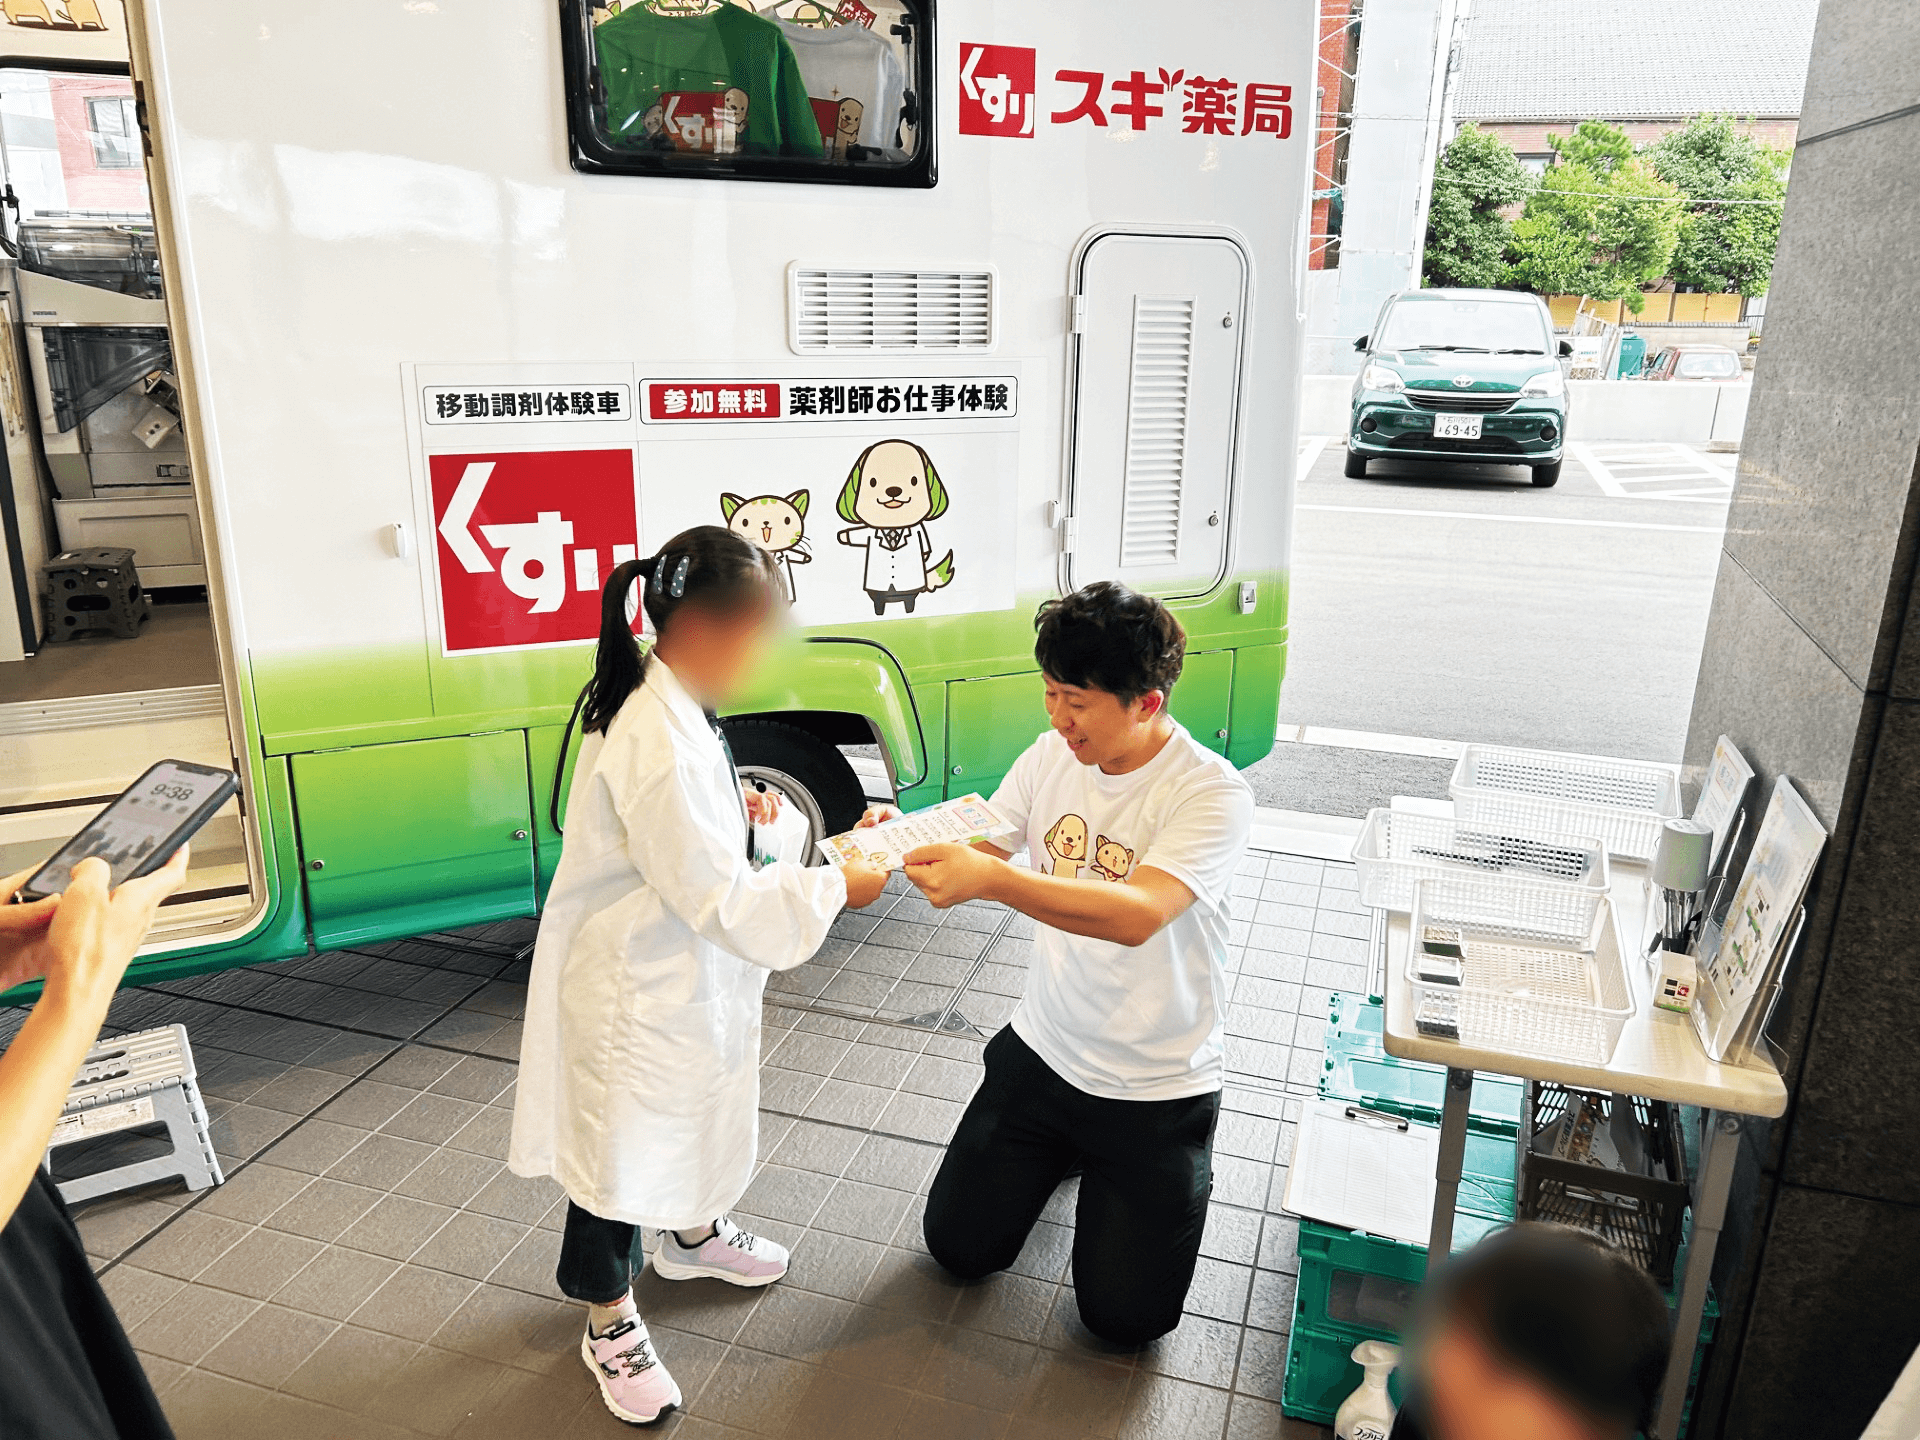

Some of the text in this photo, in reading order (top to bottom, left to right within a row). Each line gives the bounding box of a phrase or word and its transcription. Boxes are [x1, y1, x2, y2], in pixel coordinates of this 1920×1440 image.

[960, 47, 1035, 134] くすり
[1051, 67, 1292, 139] スギ薬局
[436, 392, 621, 419] 移動調剤体験車
[663, 384, 1009, 416] 参加無料 薬剤師お仕事体験
[151, 783, 193, 801] 9:38
